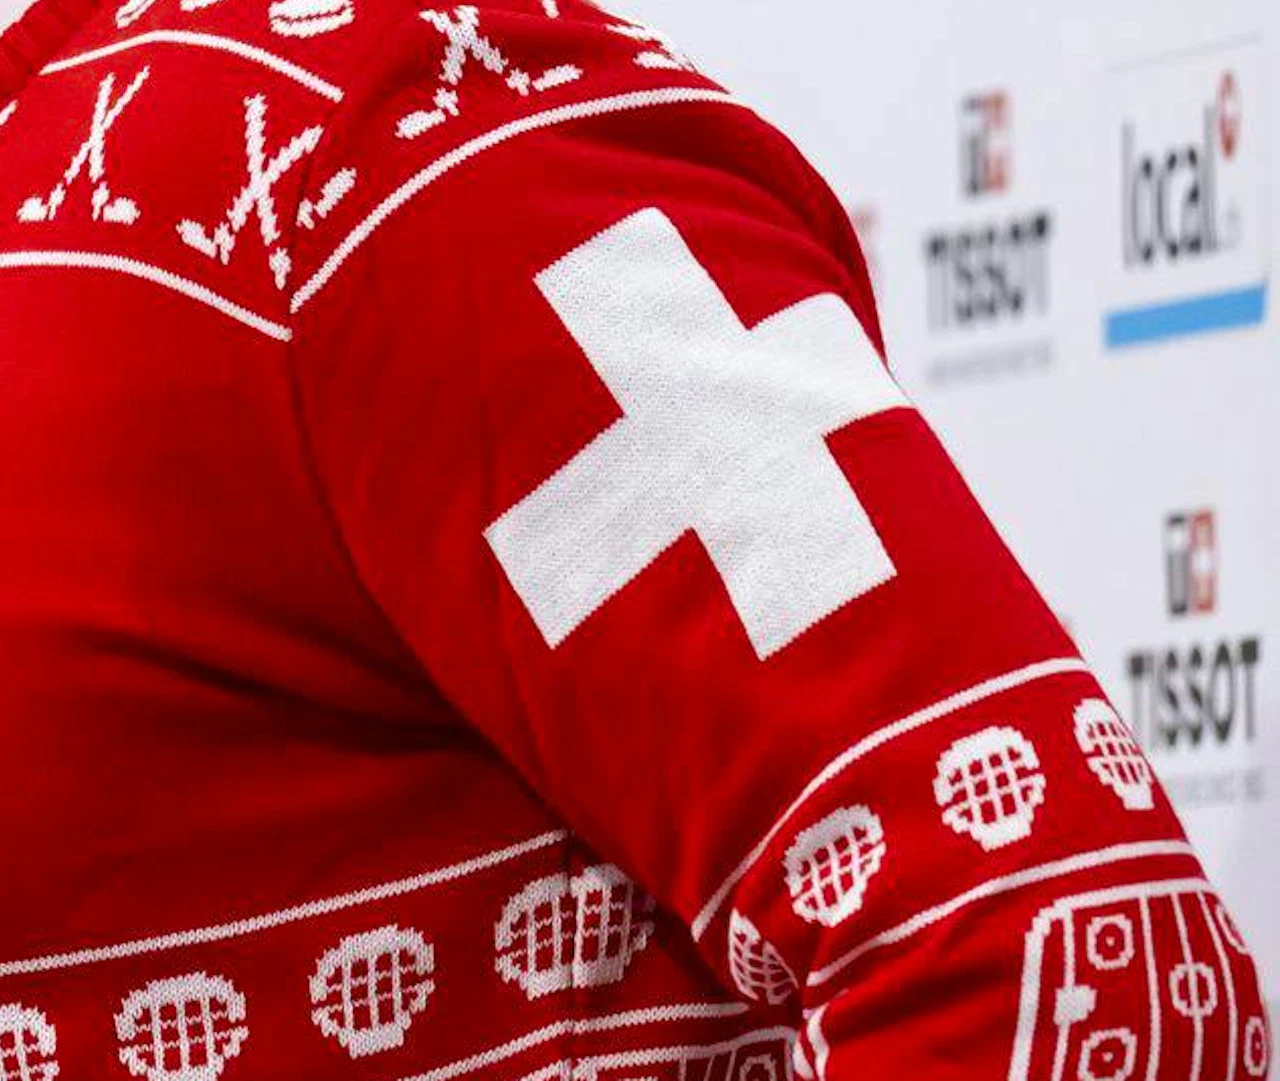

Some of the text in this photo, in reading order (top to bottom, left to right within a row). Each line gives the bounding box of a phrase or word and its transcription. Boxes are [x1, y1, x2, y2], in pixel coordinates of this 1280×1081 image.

[1122, 106, 1217, 270] local
[924, 210, 1053, 332] TISSOT
[1126, 636, 1260, 748] TISSOT
